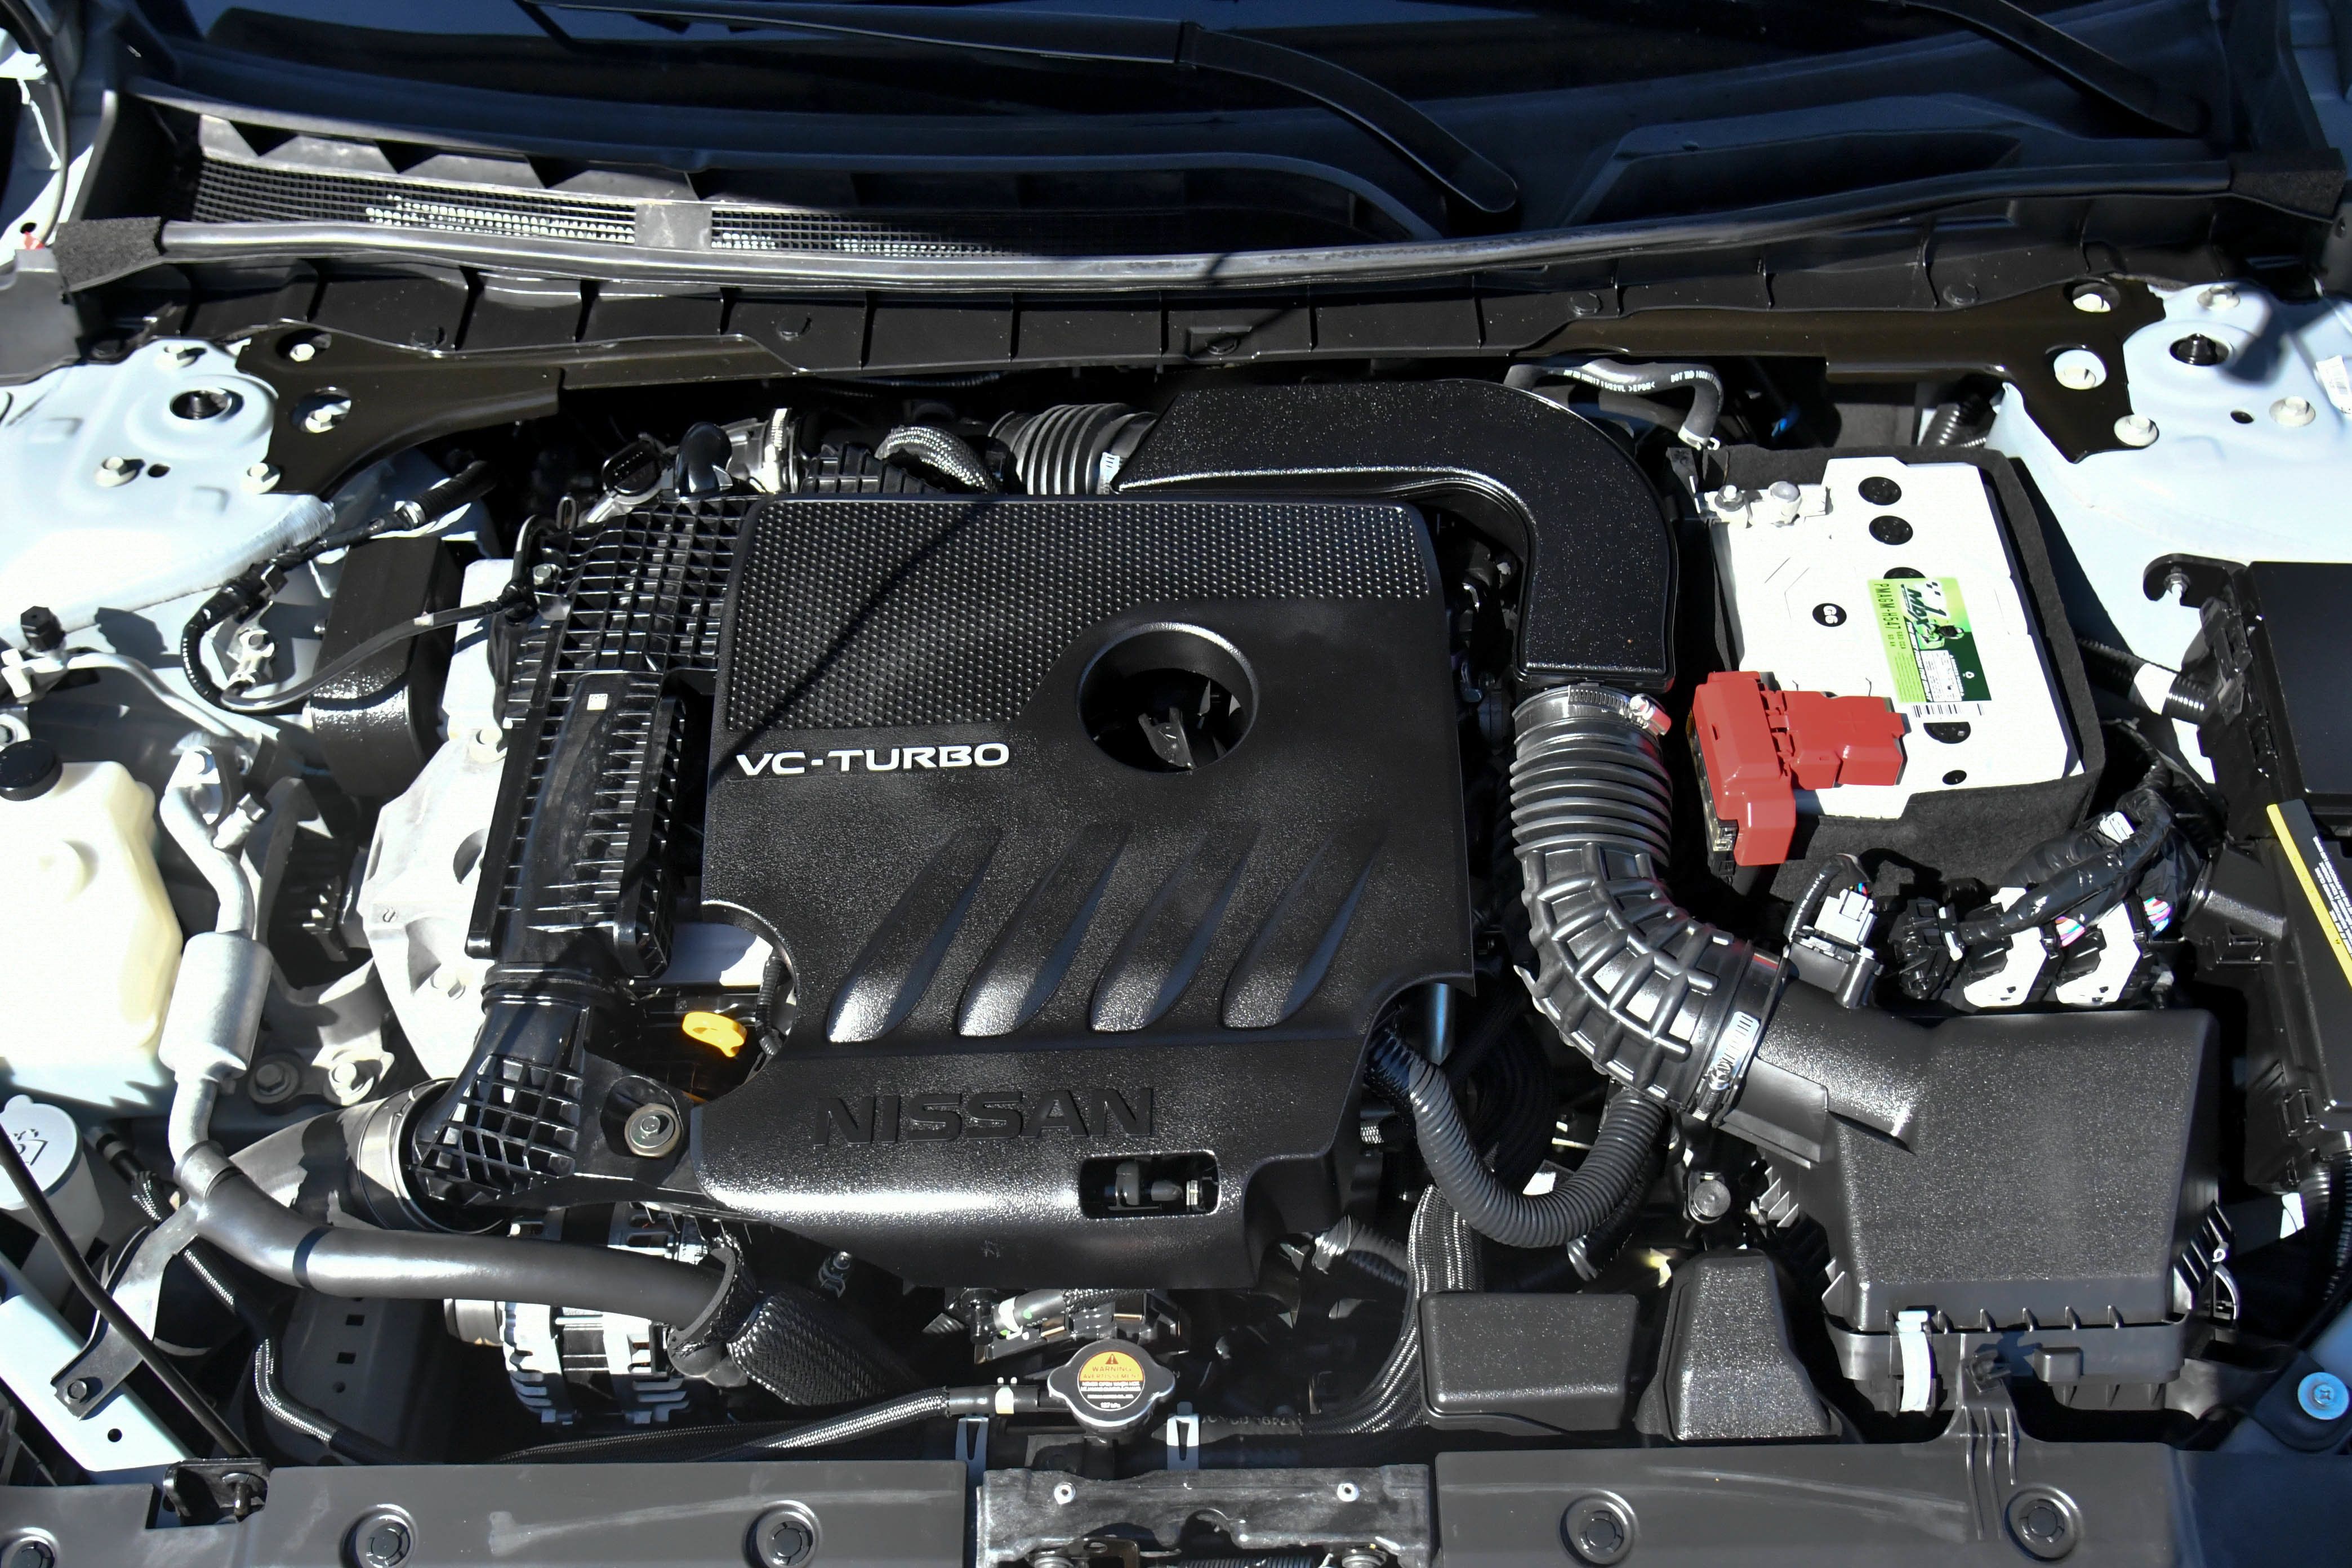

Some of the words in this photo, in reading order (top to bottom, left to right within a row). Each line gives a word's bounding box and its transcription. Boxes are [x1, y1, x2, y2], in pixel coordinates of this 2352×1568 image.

[1823, 605, 1838, 624] G6
[1874, 583, 1901, 629] PMAGM-H547
[736, 743, 1009, 776] VC-TURBO
[814, 1088, 1154, 1147] NISSAN
